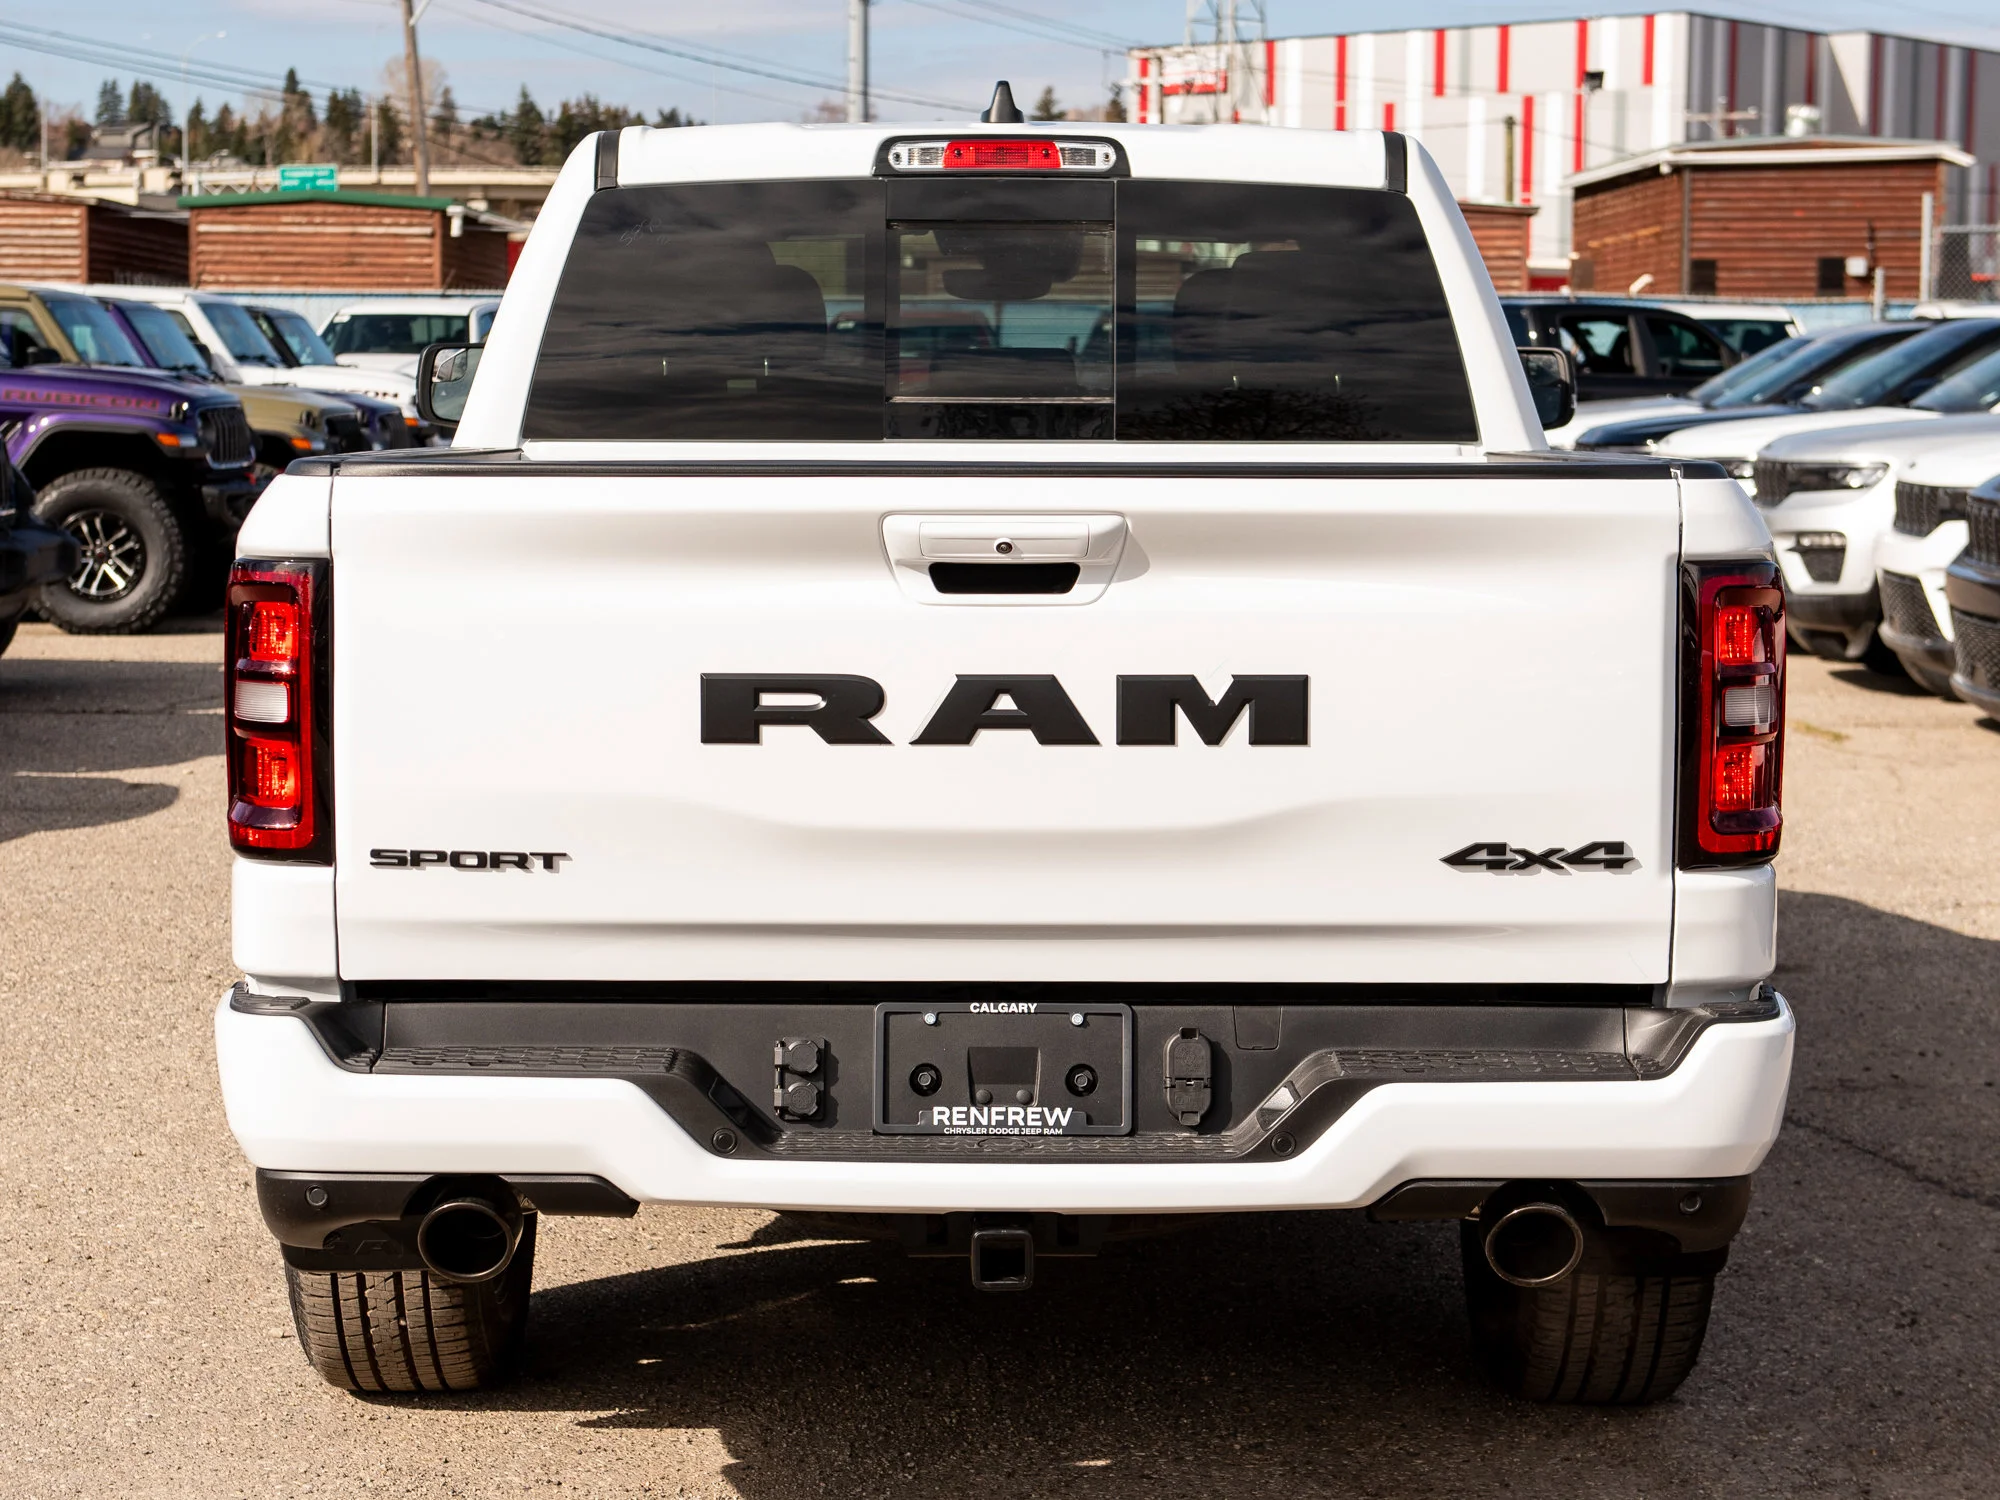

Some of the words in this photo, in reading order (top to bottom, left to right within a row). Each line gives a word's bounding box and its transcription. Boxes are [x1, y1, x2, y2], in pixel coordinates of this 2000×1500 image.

[3, 388, 159, 410] RUBICON
[700, 672, 1310, 746] RAM
[369, 848, 568, 870] SPORT
[969, 1002, 1038, 1014] CALGARY
[932, 1106, 1073, 1127] RENFREW
[943, 1127, 988, 1135] CHRYSLER
[988, 1127, 1020, 1135] DODGE
